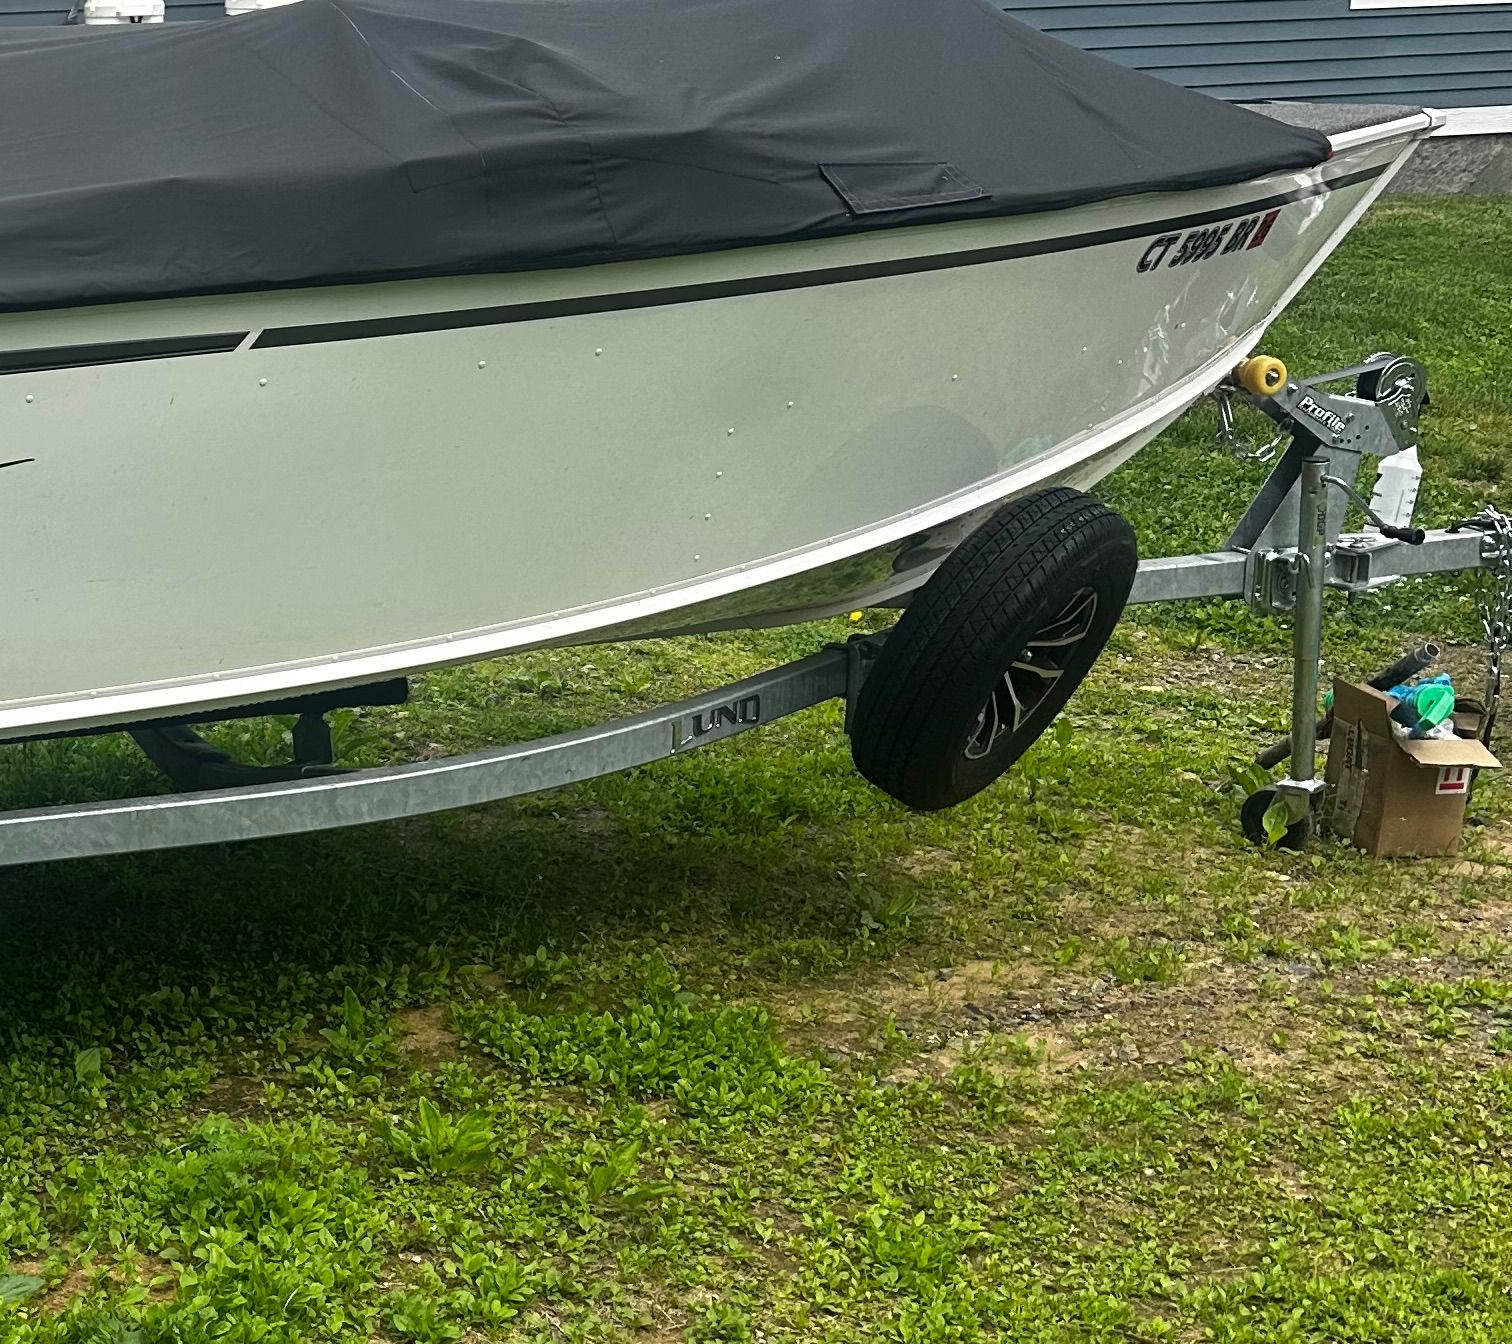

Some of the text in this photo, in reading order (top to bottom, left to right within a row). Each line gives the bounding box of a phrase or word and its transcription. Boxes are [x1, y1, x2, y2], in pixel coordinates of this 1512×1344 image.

[1136, 233, 1182, 273] CT
[1168, 222, 1233, 268] 5995
[1299, 395, 1346, 434] Profile
[671, 694, 760, 755] LUND
